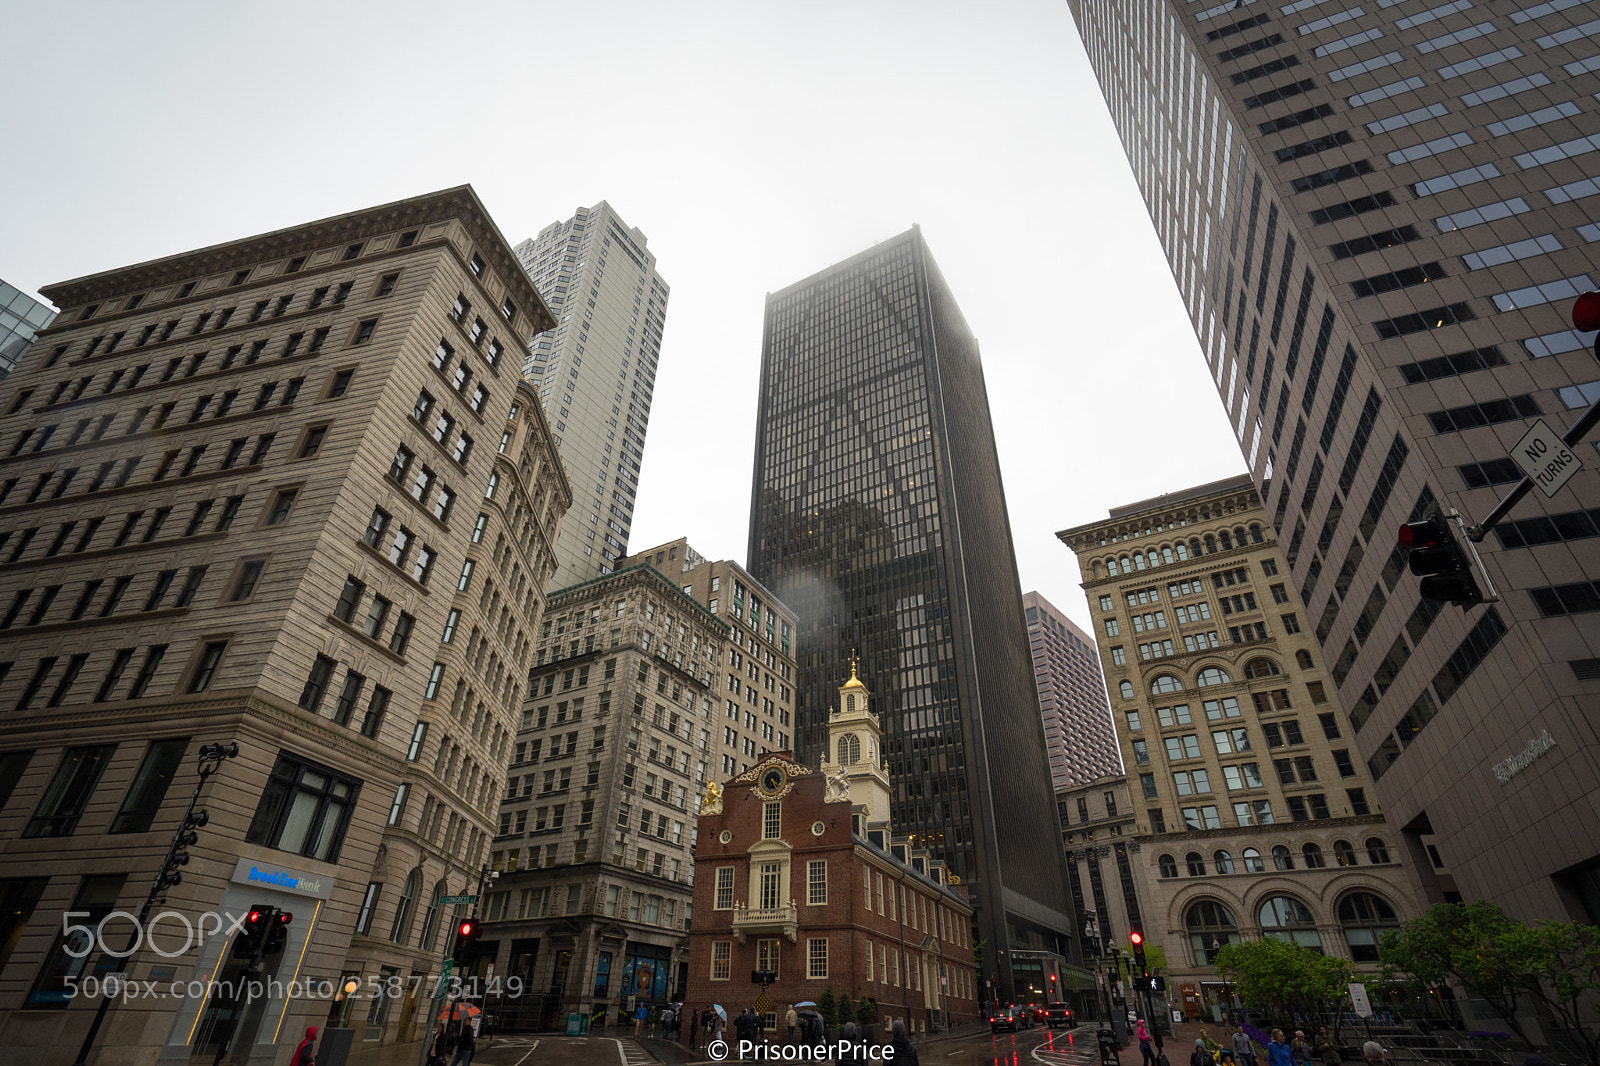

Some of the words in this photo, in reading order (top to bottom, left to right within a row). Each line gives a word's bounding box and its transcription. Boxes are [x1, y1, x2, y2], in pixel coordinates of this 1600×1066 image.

[1525, 438, 1547, 463] NO
[1536, 449, 1573, 487] TURNS
[445, 896, 470, 904] CONGRESS
